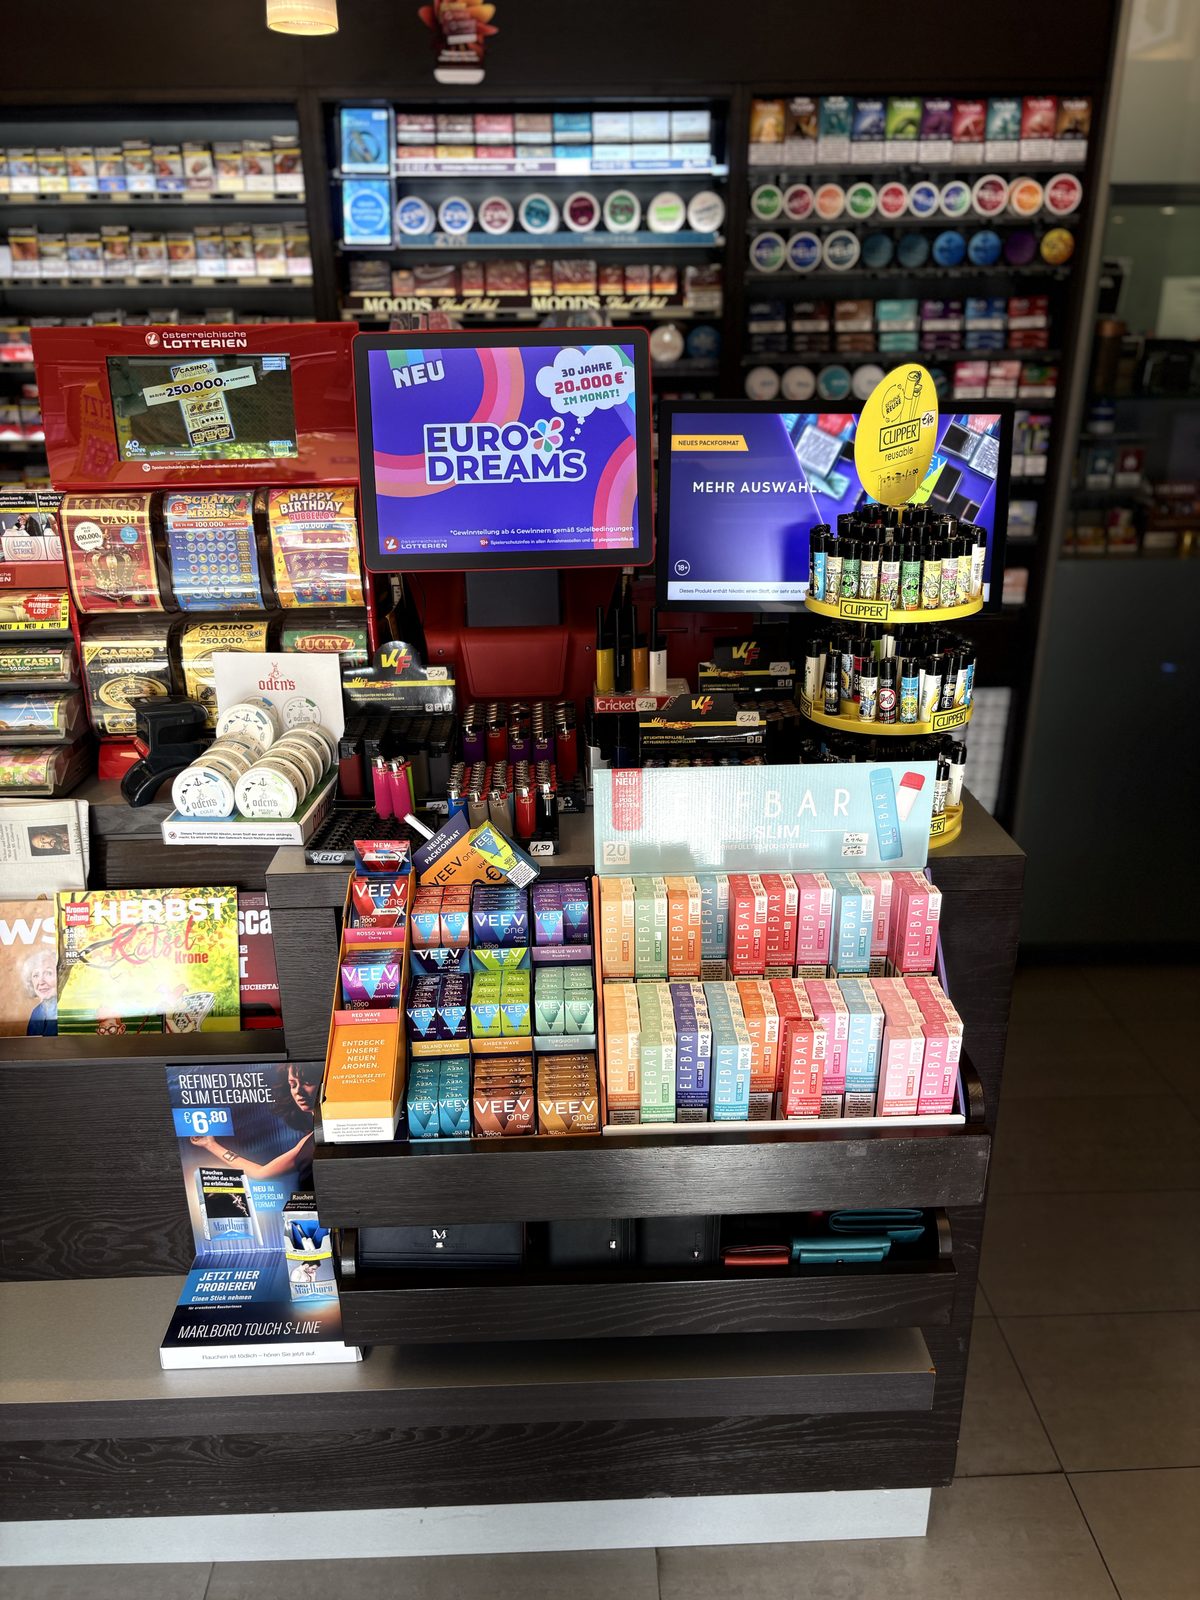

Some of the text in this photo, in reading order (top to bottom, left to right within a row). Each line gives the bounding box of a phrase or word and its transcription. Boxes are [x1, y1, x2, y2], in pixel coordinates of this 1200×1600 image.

[363, 297, 433, 312] MOODS
[531, 295, 600, 311] MOODS
[162, 331, 247, 339] österreichische
[163, 339, 247, 348] LOTTERIEN
[180, 364, 208, 374] CASINO
[392, 360, 445, 388] NEU
[561, 362, 612, 377] 30 JAHRE
[555, 374, 612, 394] 20.000
[563, 388, 620, 406] IM MONAT!
[426, 425, 529, 453] EURO
[883, 424, 918, 446] CLIPPER
[885, 446, 914, 462] reusable
[427, 451, 586, 482] DREAMS
[692, 480, 822, 494] MEHR AUSWAHL.
[184, 494, 236, 505] SCHATZ
[289, 492, 334, 502] HAPPY
[188, 508, 232, 518] MEERES
[280, 500, 344, 514] BIRTHDAY
[100, 514, 138, 524] CASH
[552, 526, 574, 535] gemäß
[576, 525, 634, 534] Spielbedingungen
[13, 540, 32, 548] LUCKY
[401, 542, 448, 550] LOTTERIEN
[33, 607, 48, 615] LOS!
[843, 604, 886, 617] CLIPPER
[297, 638, 342, 650] LUCKY
[24, 658, 52, 666] CASH
[258, 677, 296, 692] oden's
[597, 698, 635, 712] Cricket
[936, 711, 966, 728] CLIPPER
[615, 778, 638, 786] NEU!
[876, 793, 892, 846] ELFBAR
[755, 824, 801, 839] SLIM
[424, 830, 460, 865] PACKFORMAT
[426, 832, 446, 852] NEUES
[606, 844, 627, 856] 20
[320, 853, 344, 864] BIC
[354, 883, 406, 898] VEEV
[382, 898, 404, 907] one
[66, 906, 89, 914] Kronen
[93, 897, 228, 926] HERBST
[66, 914, 89, 922] Zeitung
[474, 914, 525, 927] VEEV
[503, 926, 524, 934] one
[638, 904, 650, 962] ELFBAR
[736, 901, 750, 960] ELFBAR
[842, 900, 857, 958] ELFBAR
[907, 898, 924, 958] ELFBAR
[175, 951, 208, 964] Krone
[419, 948, 460, 960] VEEV
[342, 968, 398, 982] VEEV
[374, 982, 396, 990] one
[341, 1062, 380, 1070] AROMEN.
[680, 1035, 693, 1090] ELFBAR
[792, 1035, 809, 1096] ELFBAR
[179, 1072, 268, 1090] REFINED TASTE.
[718, 1048, 732, 1104] ELFBAR
[182, 1088, 276, 1105] SLIM ELEGANCE.
[475, 1099, 531, 1114] VEEV
[541, 1100, 596, 1116] VEEV
[506, 1112, 530, 1122] one
[572, 1112, 595, 1122] one
[432, 1229, 448, 1240] M
[200, 1270, 260, 1282] JETZT HIER
[195, 1281, 256, 1293] PROBIEREN
[294, 1283, 334, 1295] Marlboro
[178, 1320, 322, 1340] MARLBORO TOUCH S-LINE
